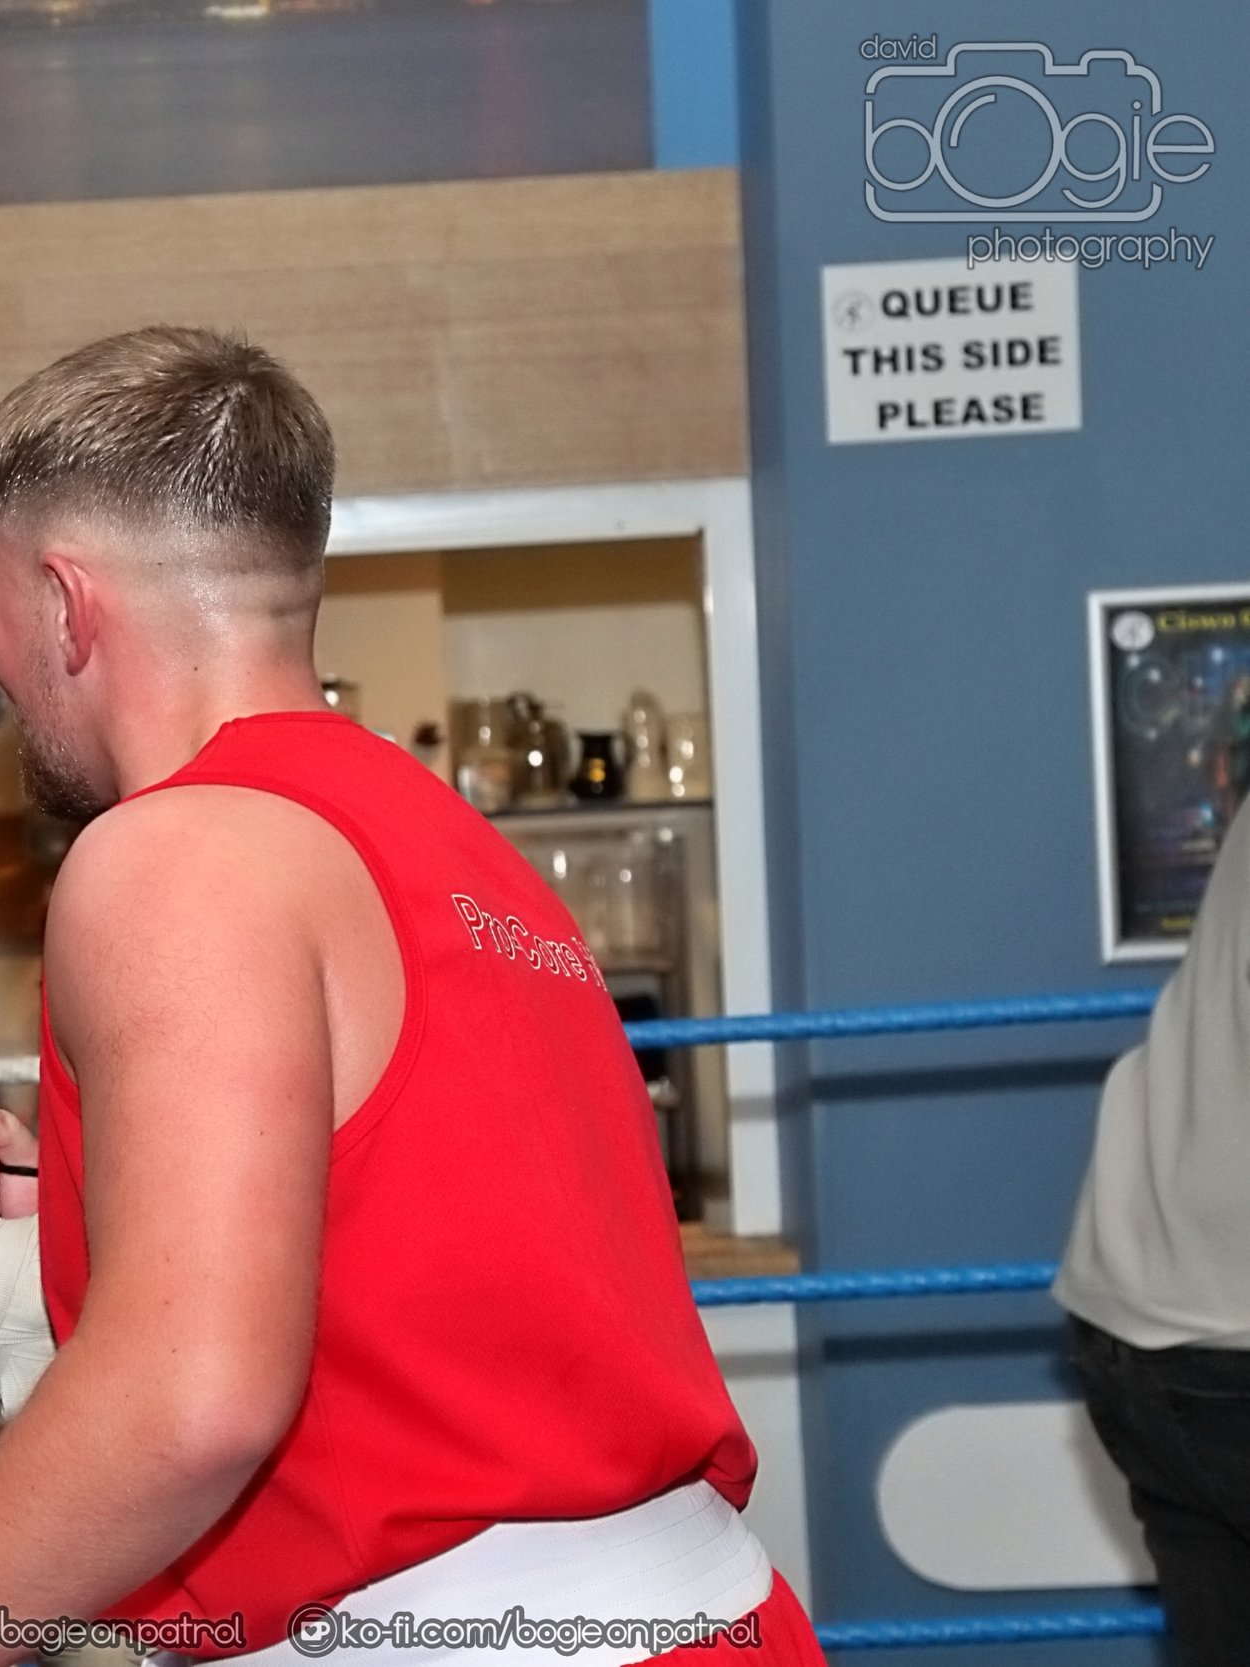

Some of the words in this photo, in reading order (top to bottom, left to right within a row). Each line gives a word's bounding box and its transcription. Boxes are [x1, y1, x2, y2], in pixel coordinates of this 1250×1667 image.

[881, 282, 1035, 319] QUEUE
[844, 343, 945, 376] THIS
[962, 336, 1062, 370] SIDE
[877, 393, 1046, 430] PLEASE
